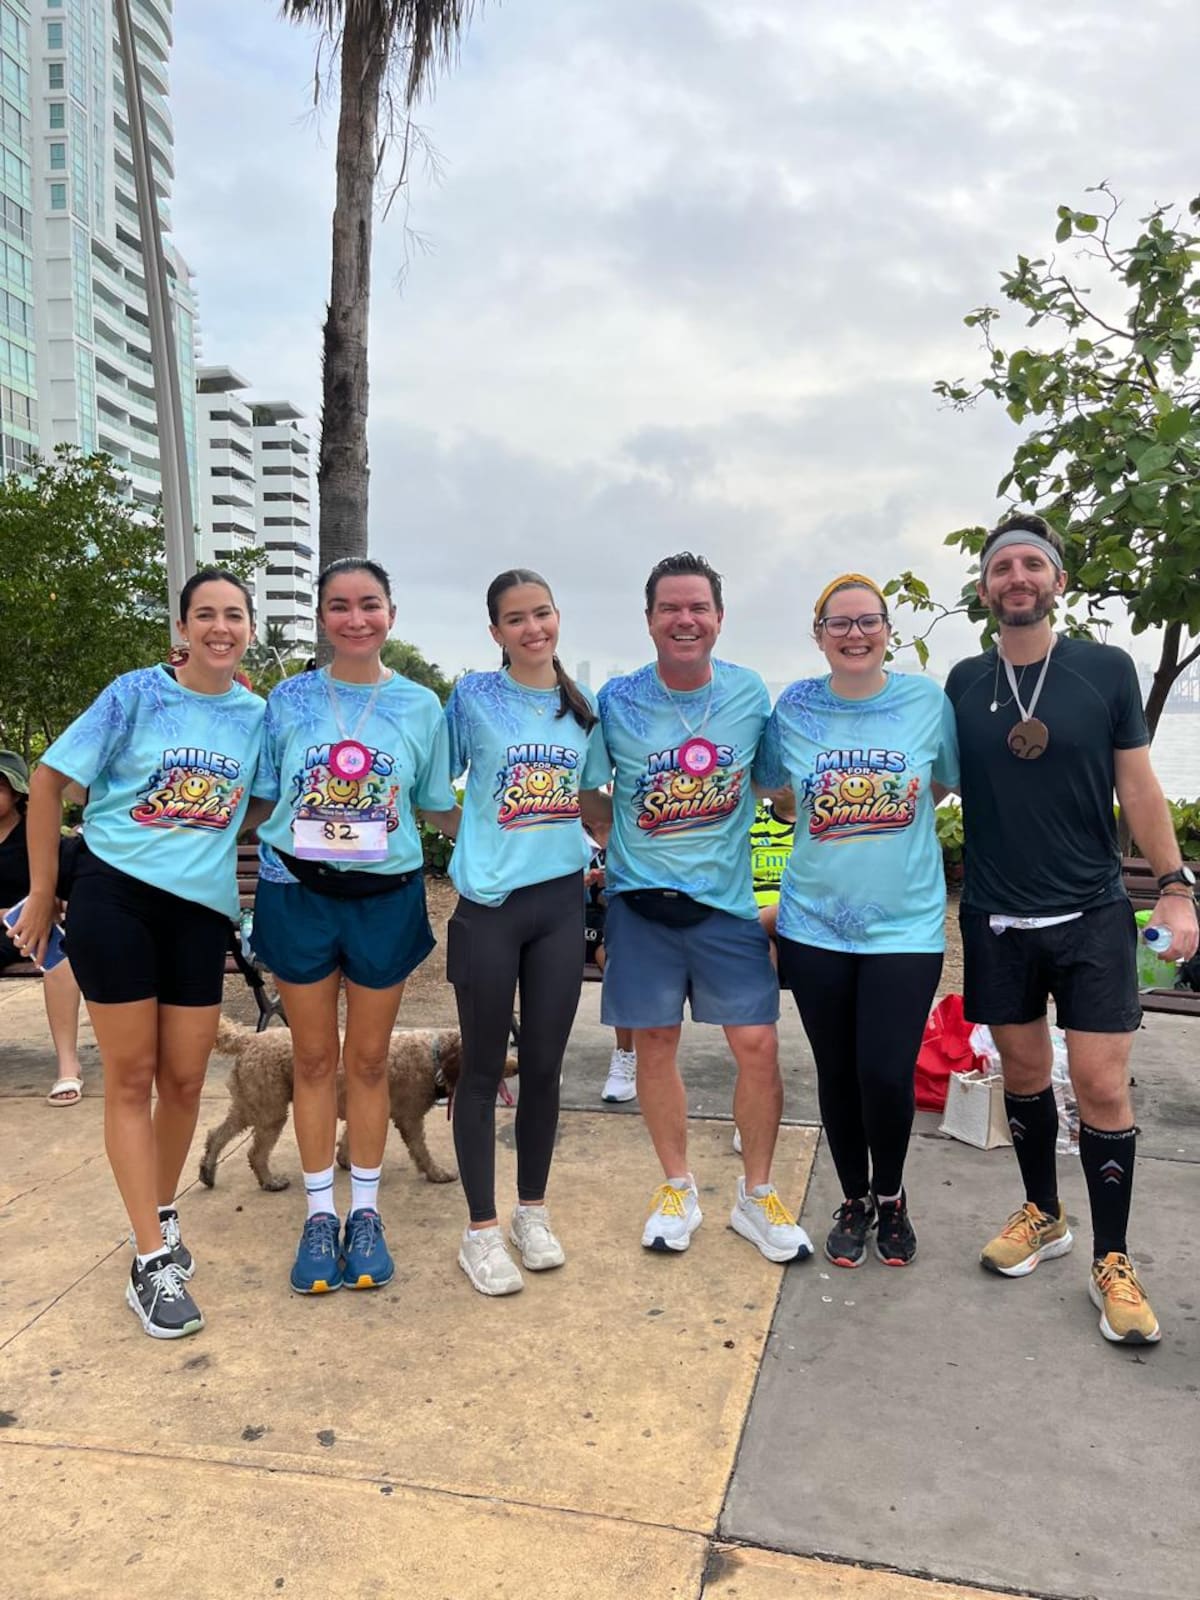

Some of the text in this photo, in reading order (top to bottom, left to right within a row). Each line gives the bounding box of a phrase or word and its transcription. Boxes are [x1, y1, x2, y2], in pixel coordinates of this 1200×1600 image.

[163, 747, 240, 780] MILES
[507, 743, 579, 769] MILES
[533, 761, 552, 771] FOR
[816, 748, 906, 774] MILES
[191, 767, 210, 776] FOR
[847, 767, 871, 775] FOR
[129, 787, 232, 823] Smiles
[497, 785, 580, 824] Smiles
[637, 787, 740, 830] Smiles
[808, 793, 914, 835] Smiles
[324, 821, 359, 840] 82
